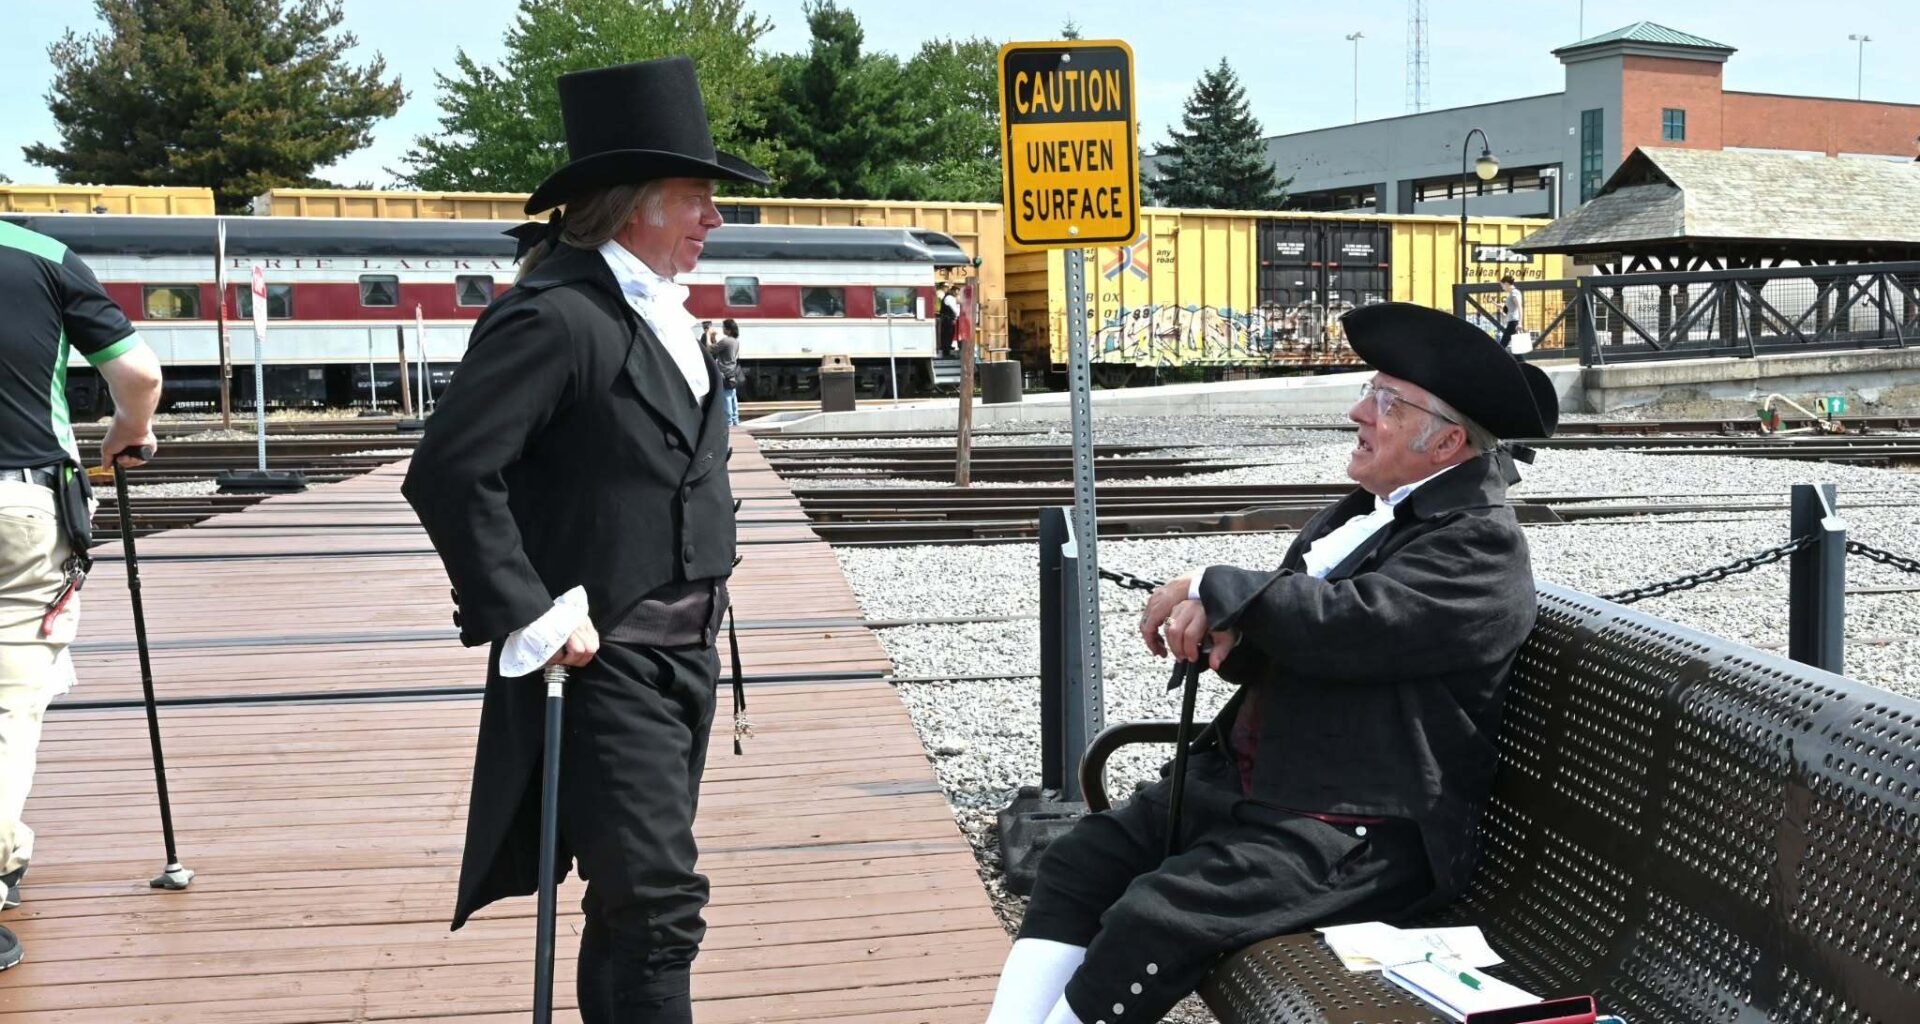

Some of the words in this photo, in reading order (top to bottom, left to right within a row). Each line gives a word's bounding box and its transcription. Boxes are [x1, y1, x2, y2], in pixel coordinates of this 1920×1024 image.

[1015, 69, 1121, 114] CAUTION
[1027, 138, 1114, 174] UNEVEN
[1022, 186, 1123, 222] SURFACE
[232, 258, 334, 269] ERIE
[362, 258, 522, 269] LACKA
[1464, 267, 1500, 278] Railcar
[1504, 267, 1544, 279] Pooling
